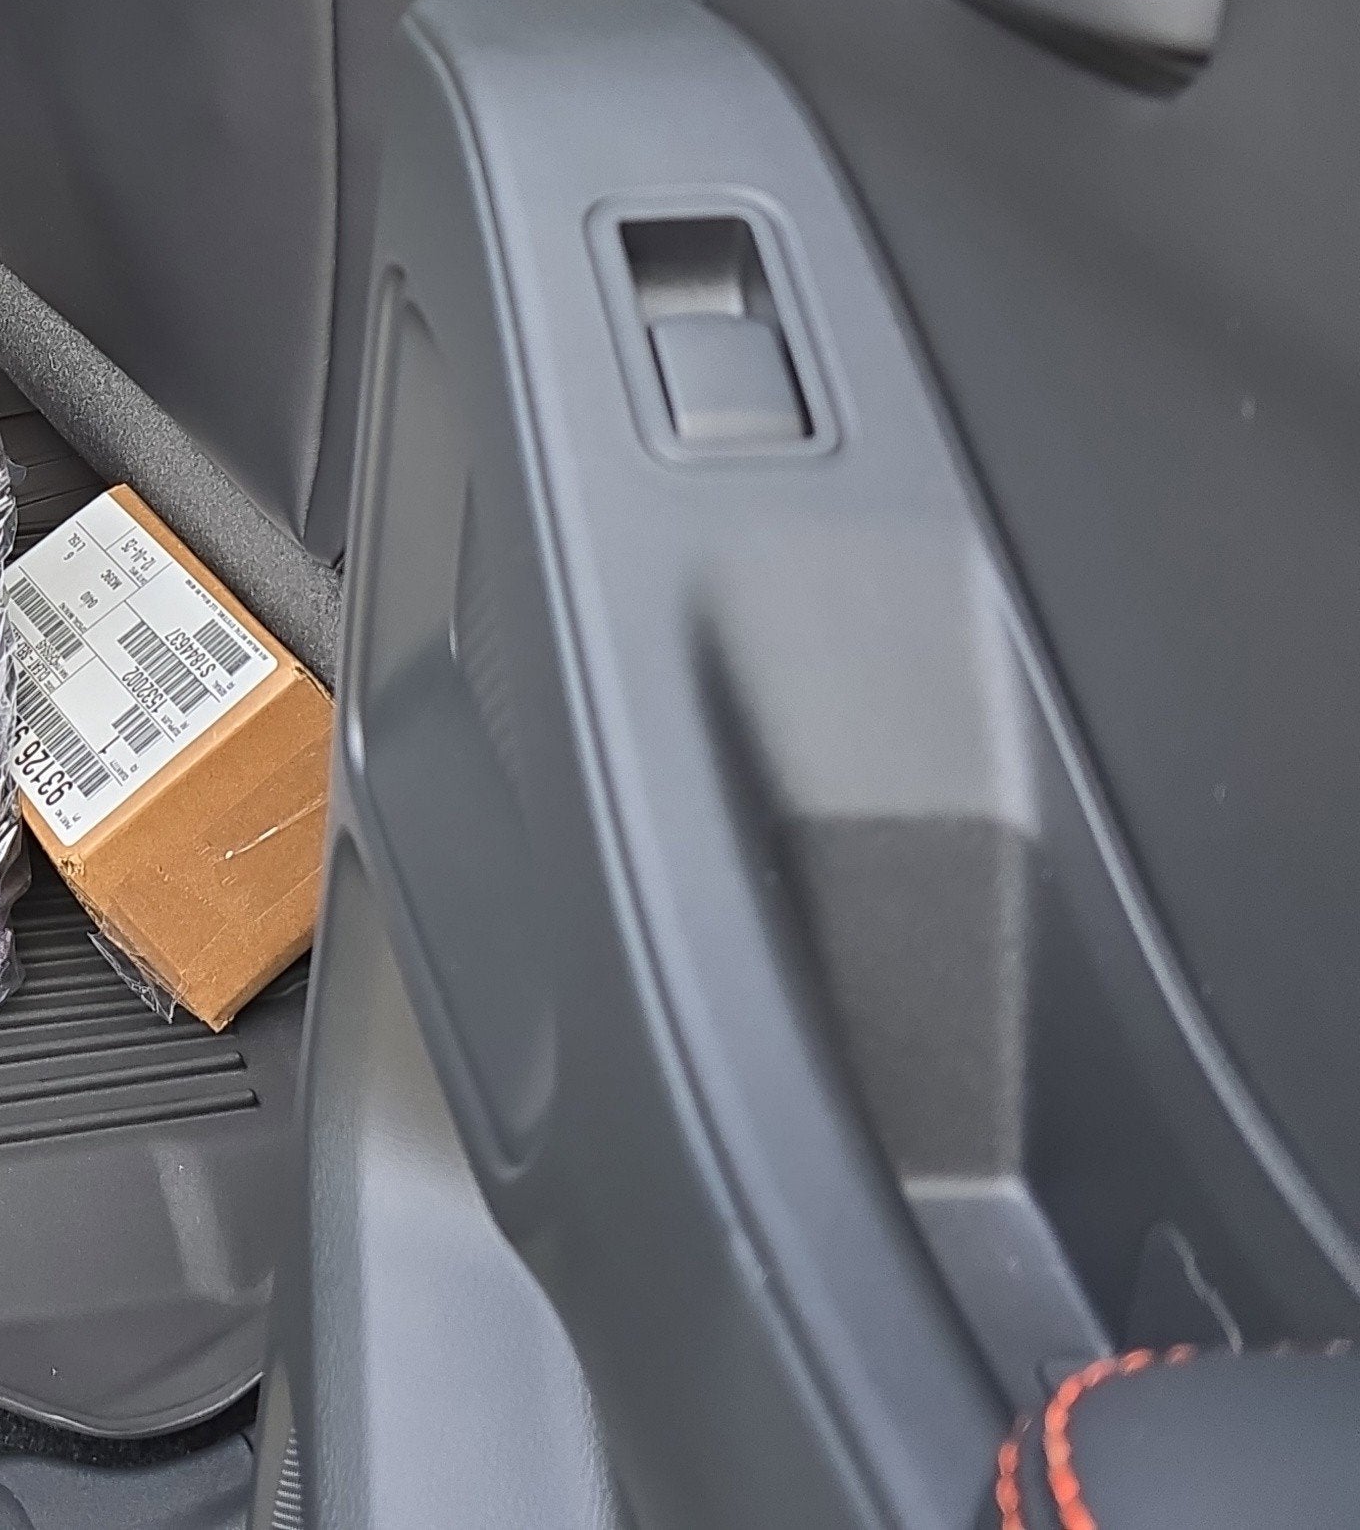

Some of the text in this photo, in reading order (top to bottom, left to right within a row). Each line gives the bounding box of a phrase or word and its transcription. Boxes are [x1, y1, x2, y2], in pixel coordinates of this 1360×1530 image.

[163, 625, 217, 679] S1844637
[120, 665, 169, 715] 1532002
[97, 734, 122, 756] 1
[14, 739, 74, 806] 93126
